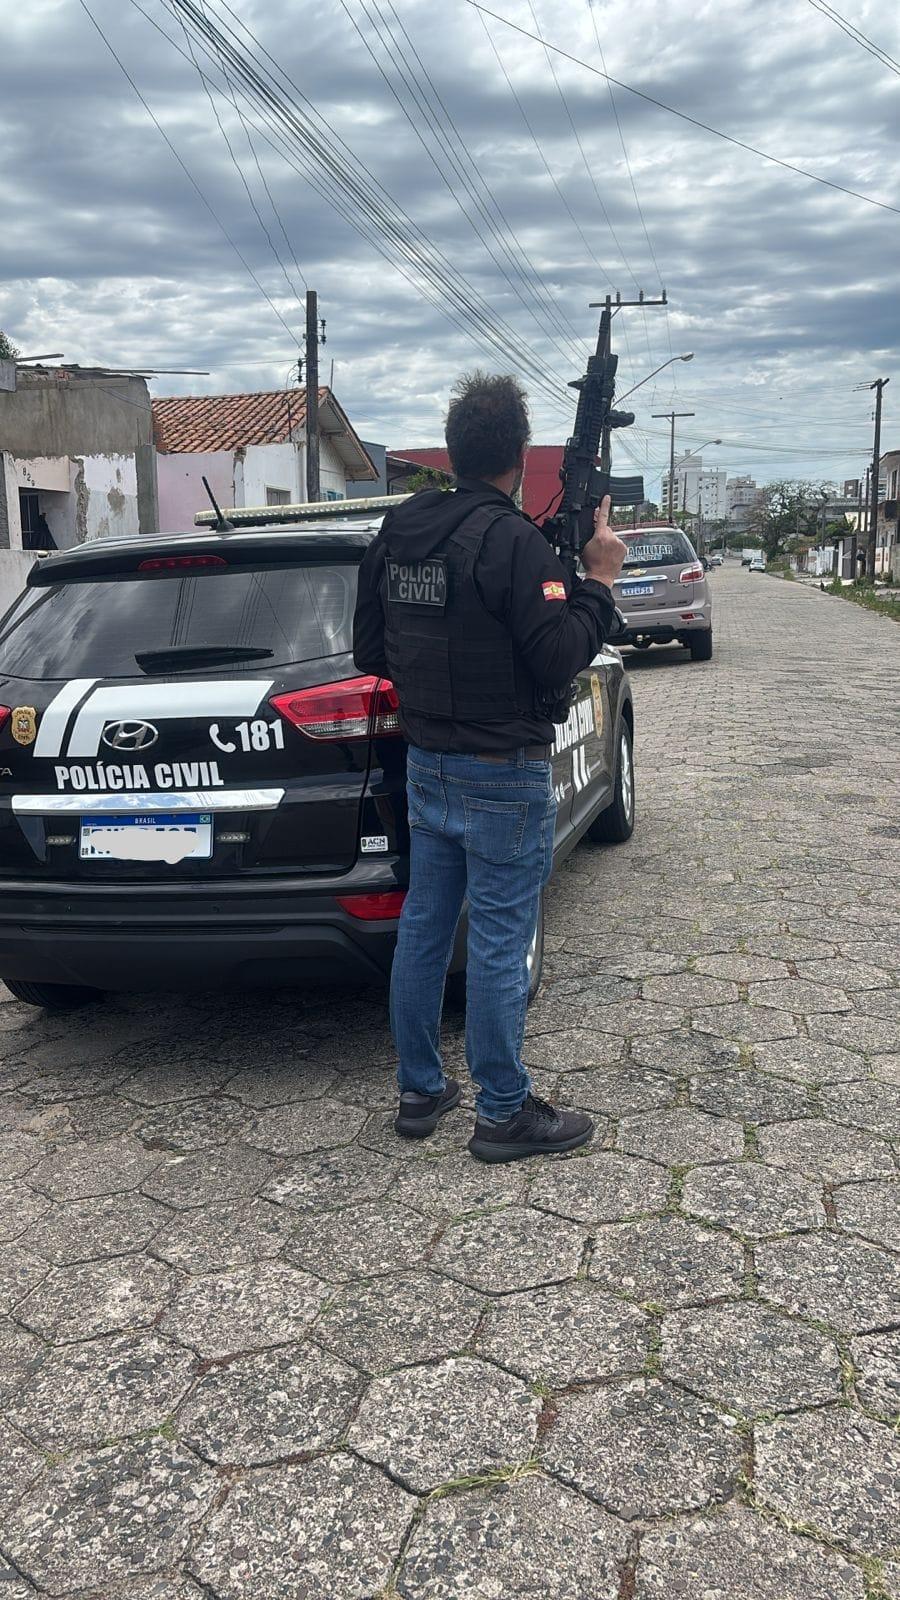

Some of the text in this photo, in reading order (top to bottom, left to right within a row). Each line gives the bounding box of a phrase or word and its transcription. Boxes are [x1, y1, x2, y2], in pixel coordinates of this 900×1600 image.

[635, 544, 673, 556] MILITAR
[398, 582, 440, 602] CIVIL
[235, 719, 285, 752] 181
[54, 761, 224, 790] POLÍCIA CIVIL
